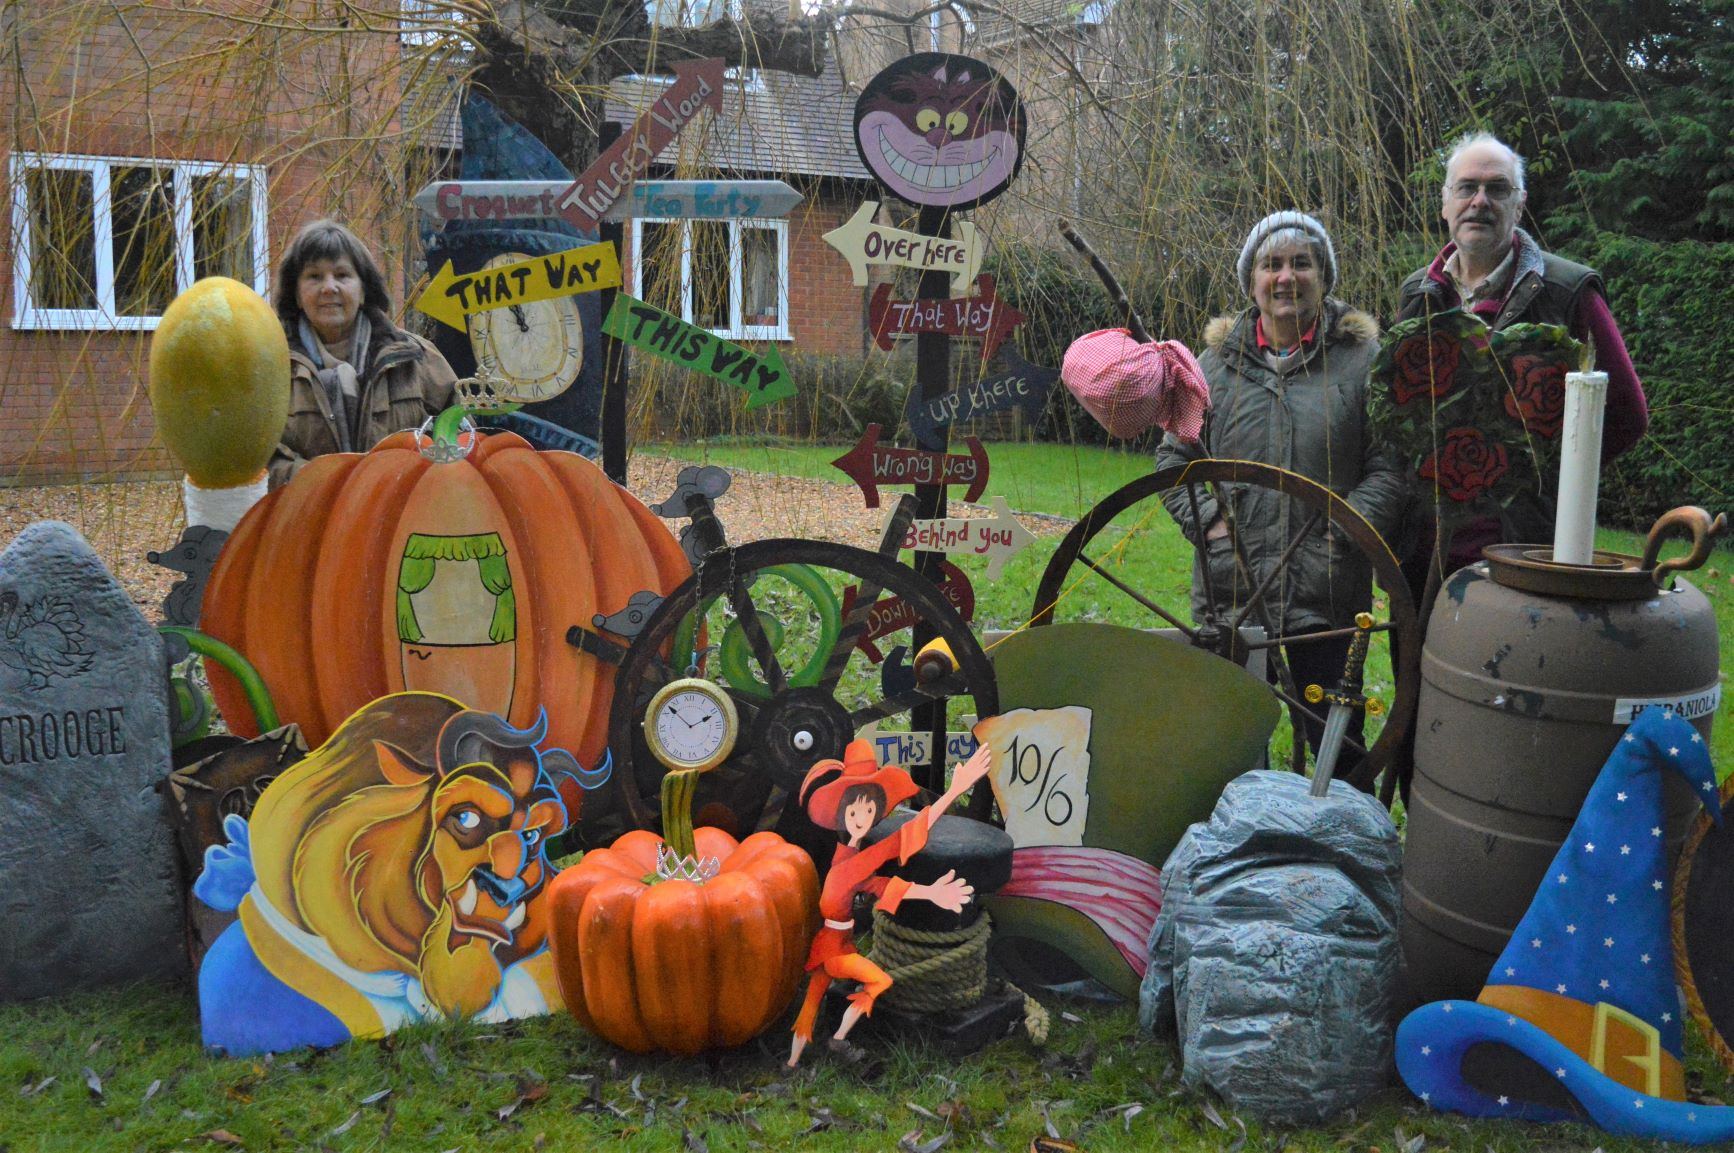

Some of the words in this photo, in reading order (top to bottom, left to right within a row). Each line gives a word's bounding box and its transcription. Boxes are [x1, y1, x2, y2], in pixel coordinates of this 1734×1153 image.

[651, 75, 713, 133] Wood
[436, 184, 554, 221] Croquet
[634, 184, 682, 217] Tea
[695, 184, 762, 217] Party
[864, 231, 920, 261] Over
[922, 239, 966, 266] here
[445, 267, 532, 309] THAT
[544, 254, 601, 289] WAY
[893, 303, 944, 329] That
[956, 302, 996, 332] Way
[711, 341, 780, 391] WAY
[929, 394, 960, 422] up
[968, 376, 1030, 410] there
[873, 453, 933, 483] Wrong
[901, 521, 968, 549] Behind
[974, 527, 1013, 554] you
[1631, 693, 1716, 721] HANIOLA
[876, 735, 925, 765] This
[946, 735, 977, 759] ay
[1003, 735, 1073, 826] 10/6
